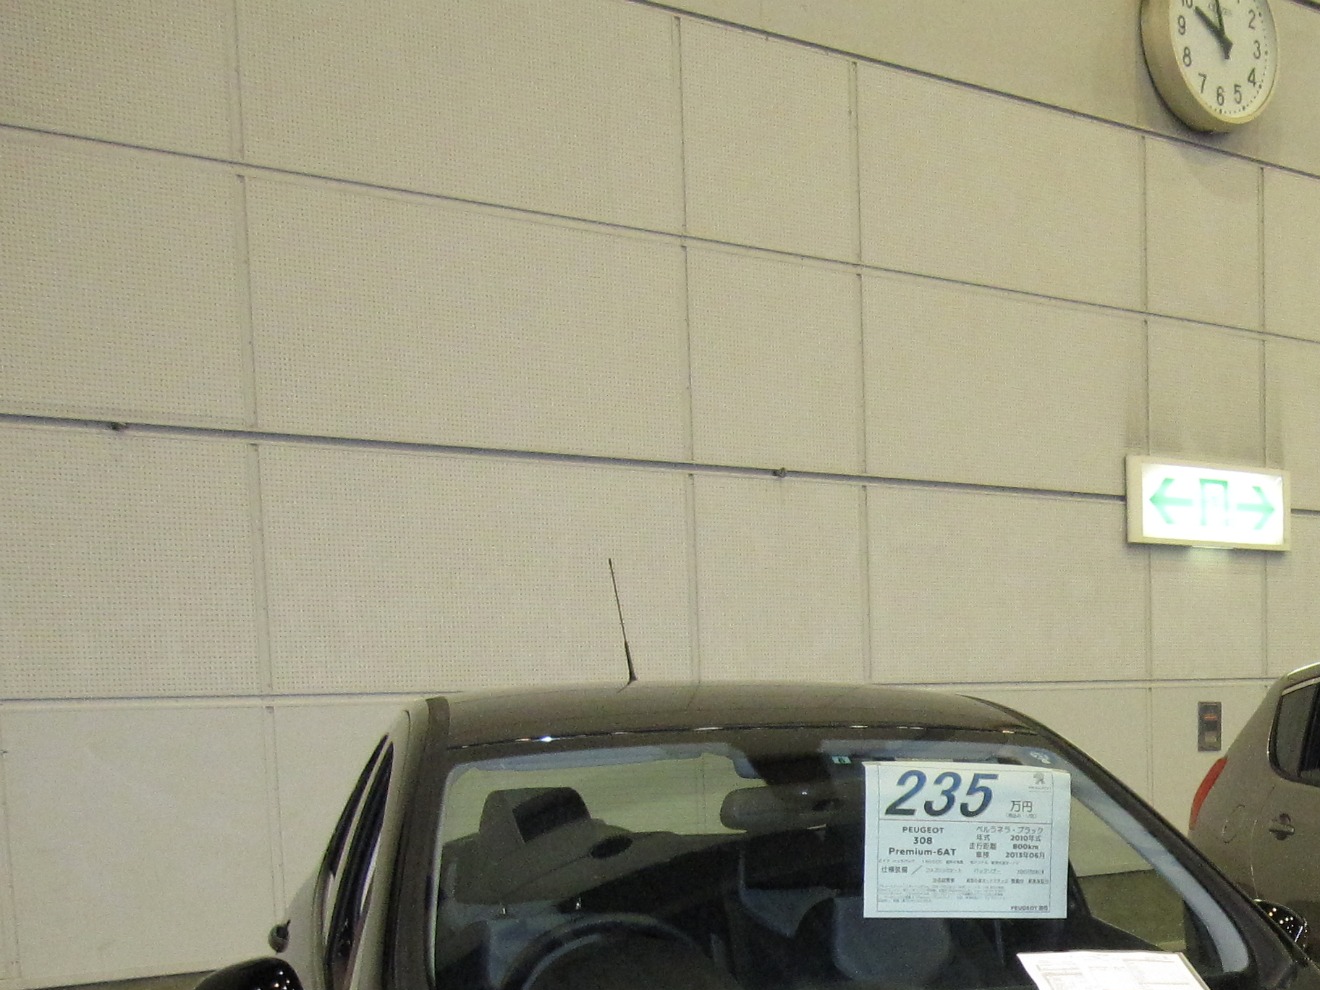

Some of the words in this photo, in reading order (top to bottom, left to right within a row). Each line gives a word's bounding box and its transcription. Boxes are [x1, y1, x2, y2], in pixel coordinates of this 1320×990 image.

[1177, 15, 1186, 35] 9
[1248, 9, 1256, 30] 2
[1182, 46, 1192, 67] 8
[1253, 40, 1261, 59] 3
[1198, 73, 1207, 94] 7
[1247, 67, 1257, 88] 4
[1216, 86, 1225, 106] 6
[1233, 84, 1242, 104] 5
[884, 769, 999, 818] 235
[1009, 800, 1034, 813] 万円
[902, 826, 944, 834] PEUGEOT
[976, 834, 991, 842] 年式
[913, 836, 933, 845] 308
[969, 842, 997, 851] 走行距離
[888, 847, 957, 856] Premium-6AT
